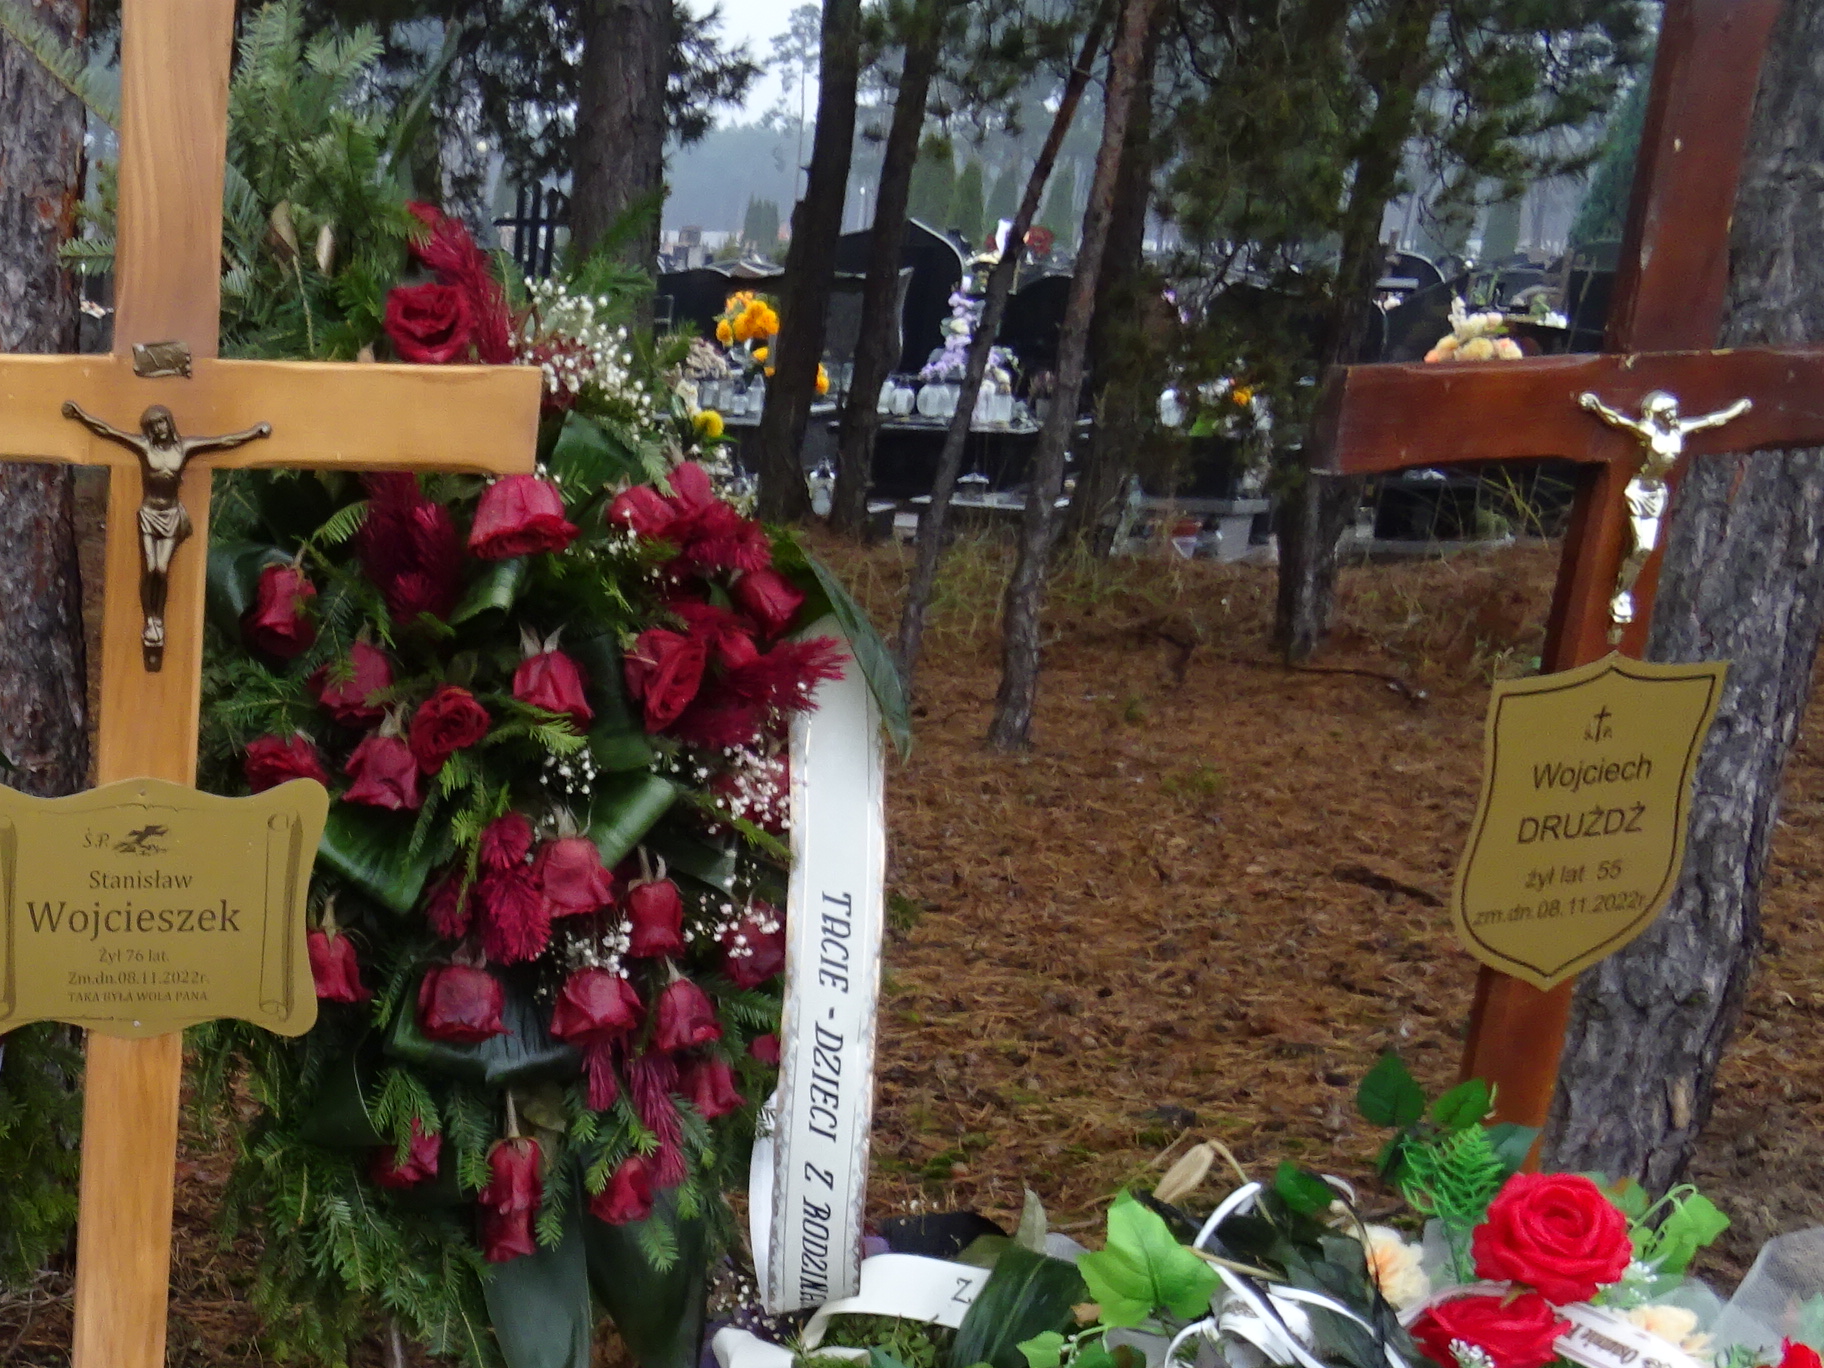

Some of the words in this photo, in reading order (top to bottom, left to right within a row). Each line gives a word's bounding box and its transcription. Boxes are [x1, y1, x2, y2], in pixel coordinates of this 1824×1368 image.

[1533, 752, 1653, 793] Wojciech
[89, 869, 193, 890] Stanisław
[1560, 864, 1587, 884] lat
[1597, 857, 1624, 883] 55
[26, 899, 241, 942] Wojcieszek
[125, 948, 144, 962] 76
[818, 890, 852, 995] TACIE
[67, 990, 100, 1003] TAKA
[136, 991, 172, 1003] WOLA
[175, 991, 208, 1003] PANA
[802, 1161, 834, 1190] Z
